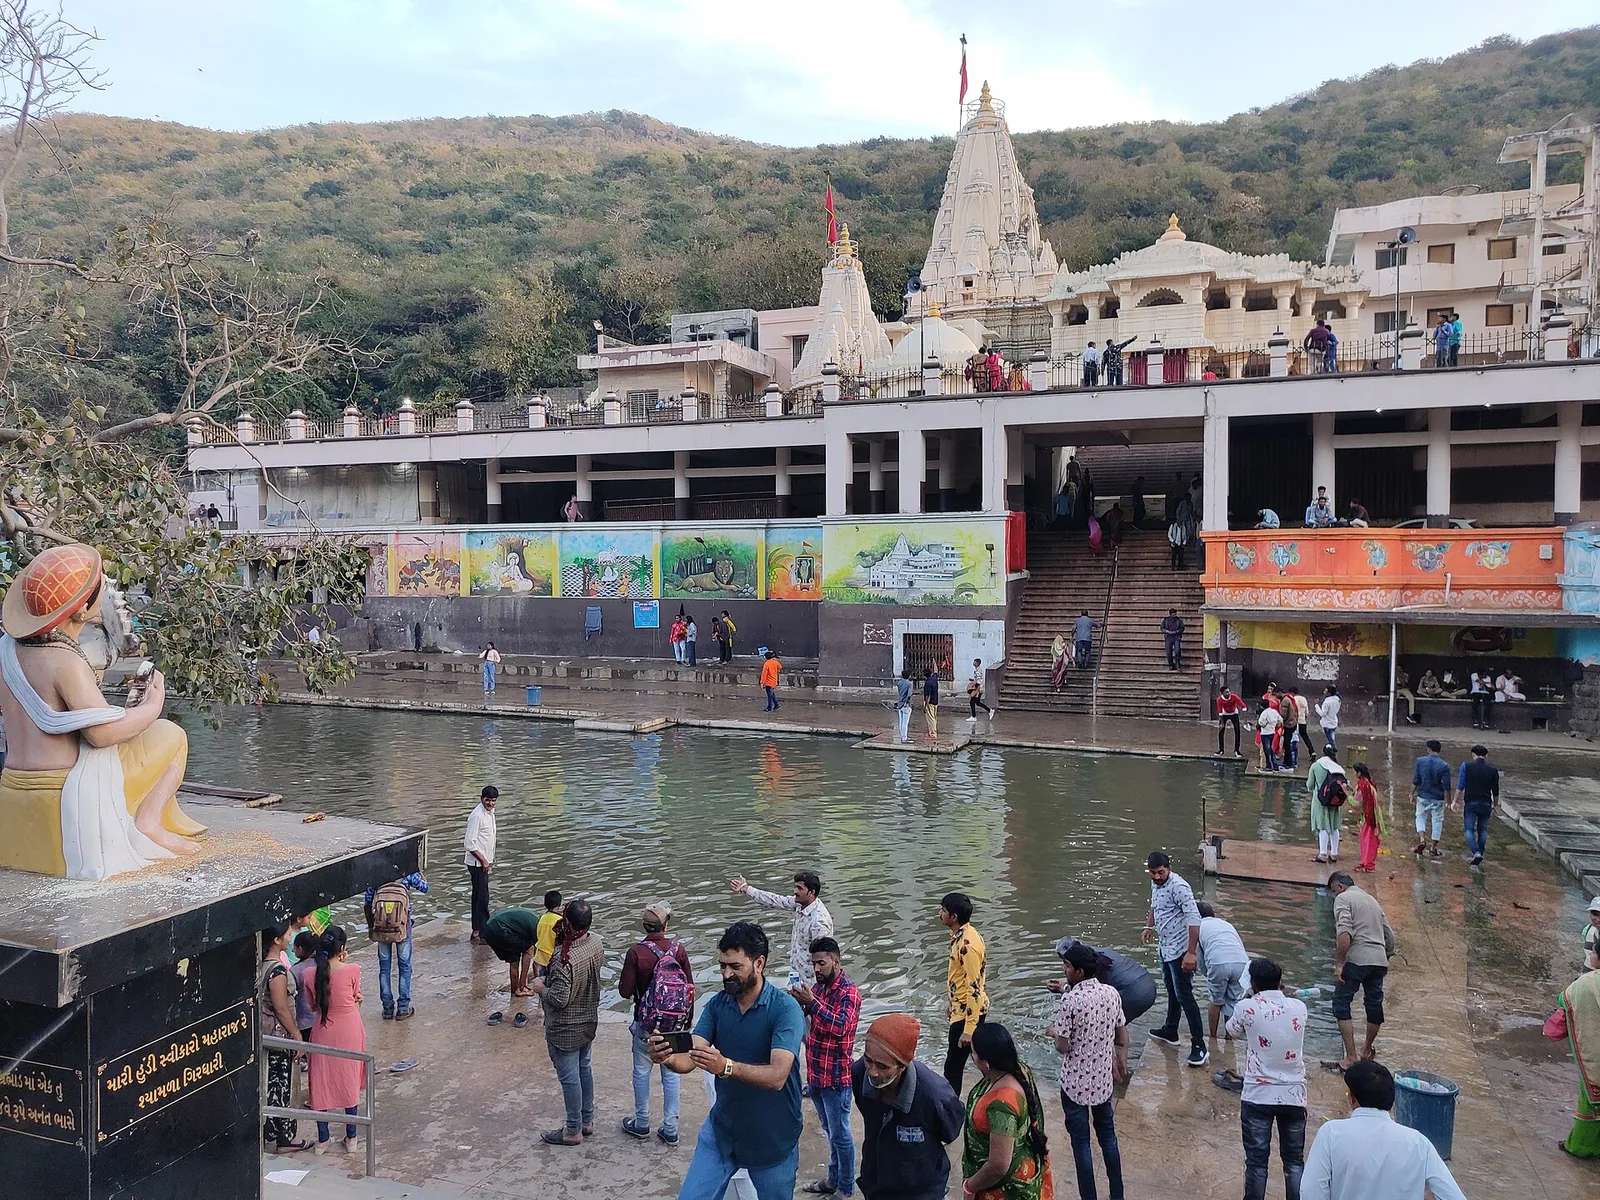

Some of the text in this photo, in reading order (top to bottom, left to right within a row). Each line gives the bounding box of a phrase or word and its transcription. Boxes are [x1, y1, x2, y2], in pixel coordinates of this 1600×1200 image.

[106, 1010, 248, 1092] મારી હુંડી સ્વીકારો મહારાજ રે
[37, 1071, 53, 1094] એક
[183, 1052, 223, 1087] ગિરધારી
[27, 1105, 52, 1126] અનંત
[54, 1109, 76, 1130] ભાસે
